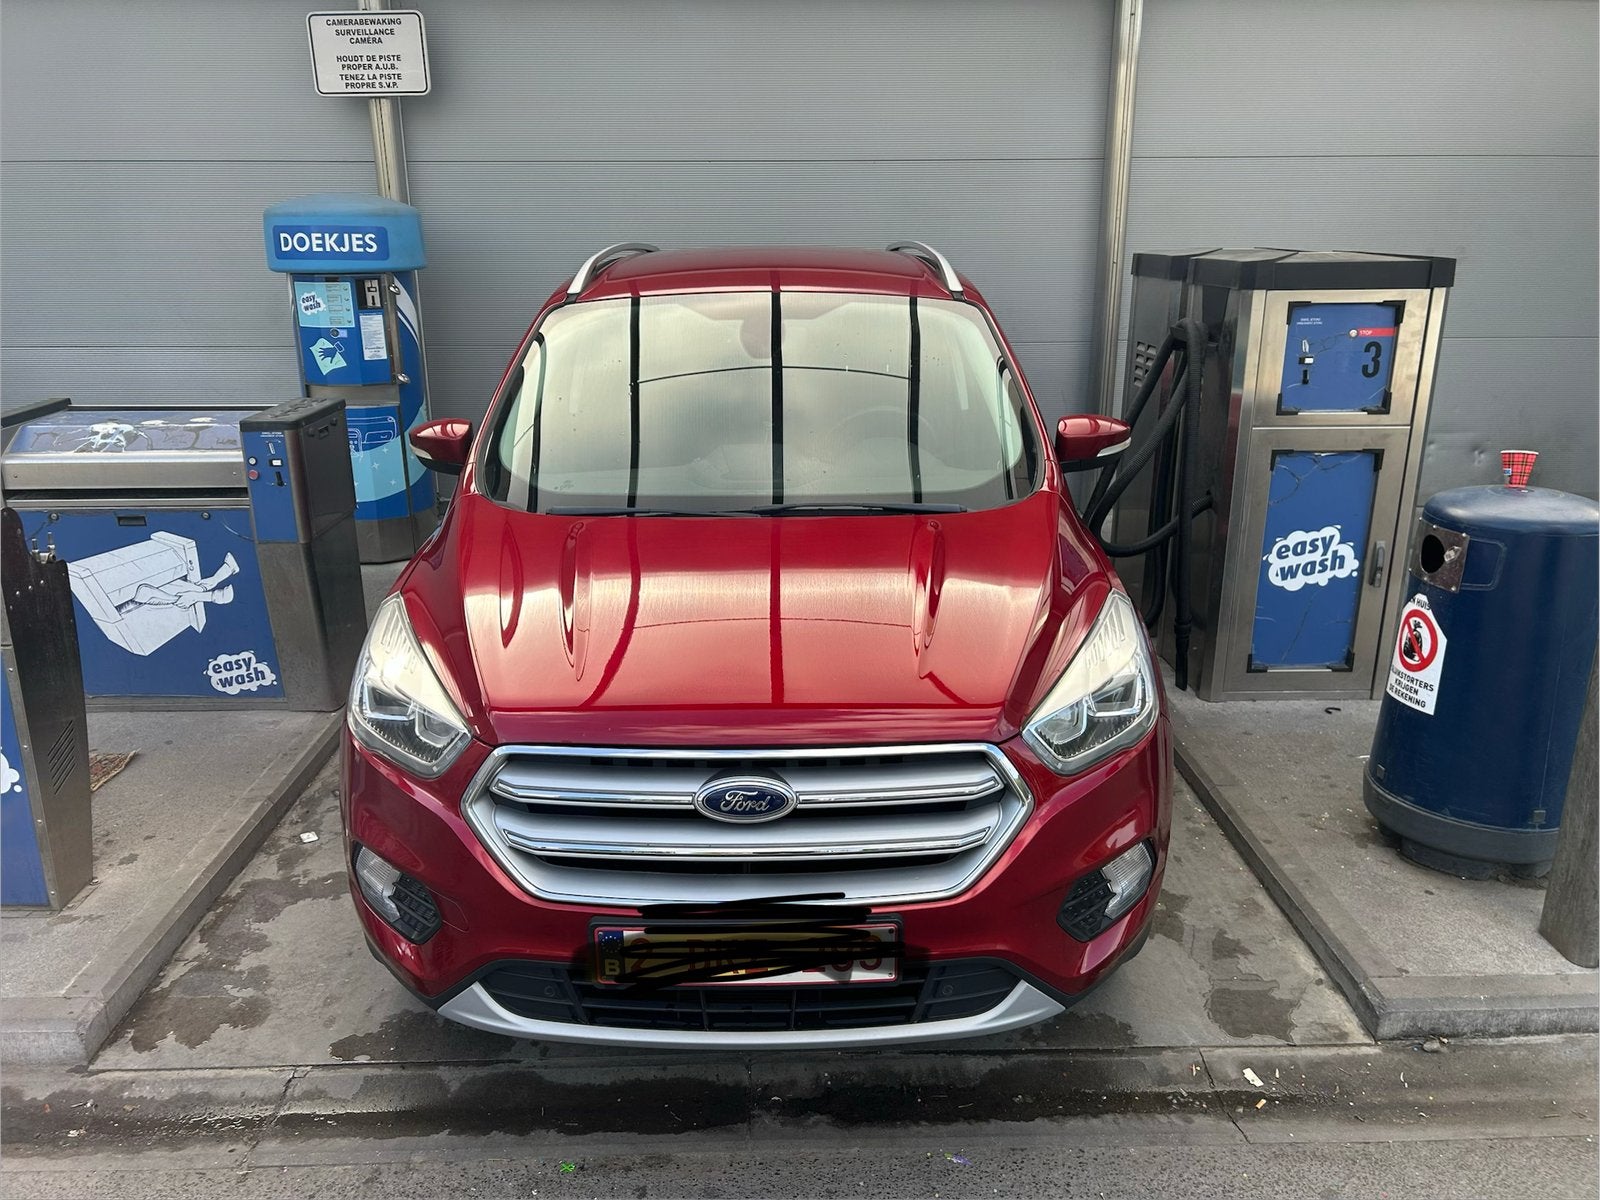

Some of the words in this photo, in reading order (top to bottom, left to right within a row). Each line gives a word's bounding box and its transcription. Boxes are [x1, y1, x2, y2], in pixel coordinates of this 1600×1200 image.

[326, 18, 402, 26] CAMERABEWAKING
[335, 28, 395, 36] SURVEILLANCE
[341, 63, 373, 71] PROPER
[378, 81, 399, 89] S.V.P.
[279, 232, 378, 253] DOEKJES
[301, 294, 316, 304] easy
[304, 300, 321, 311] wash
[1361, 341, 1382, 378] 3
[1276, 534, 1336, 560] easy
[1279, 549, 1346, 581] wash
[212, 656, 252, 674] easy
[218, 666, 266, 688] wash
[1394, 678, 1419, 696] KRIJGEN
[1395, 686, 1426, 708] REKENING
[720, 790, 770, 811] Ford
[605, 959, 620, 975] B
